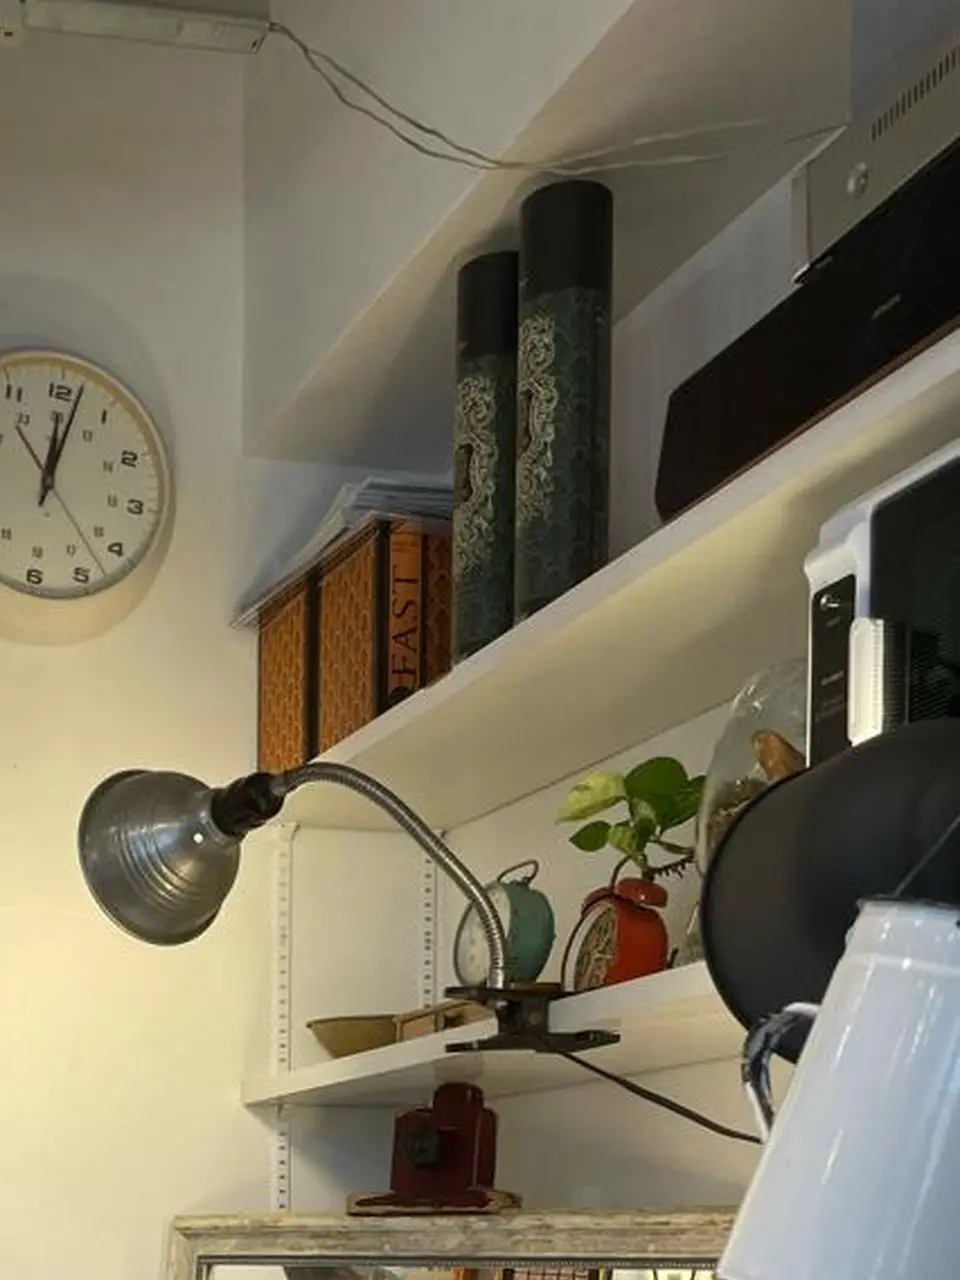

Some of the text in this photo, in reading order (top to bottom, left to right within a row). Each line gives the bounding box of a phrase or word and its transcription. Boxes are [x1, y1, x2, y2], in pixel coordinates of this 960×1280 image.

[4, 383, 23, 402] 11
[48, 381, 73, 402] 12
[100, 408, 108, 425] 1
[120, 450, 139, 468] 2
[126, 499, 145, 516] 3
[106, 541, 125, 558] 4
[25, 568, 44, 585] 6
[71, 566, 91, 584] 5
[391, 563, 417, 688] FAST
